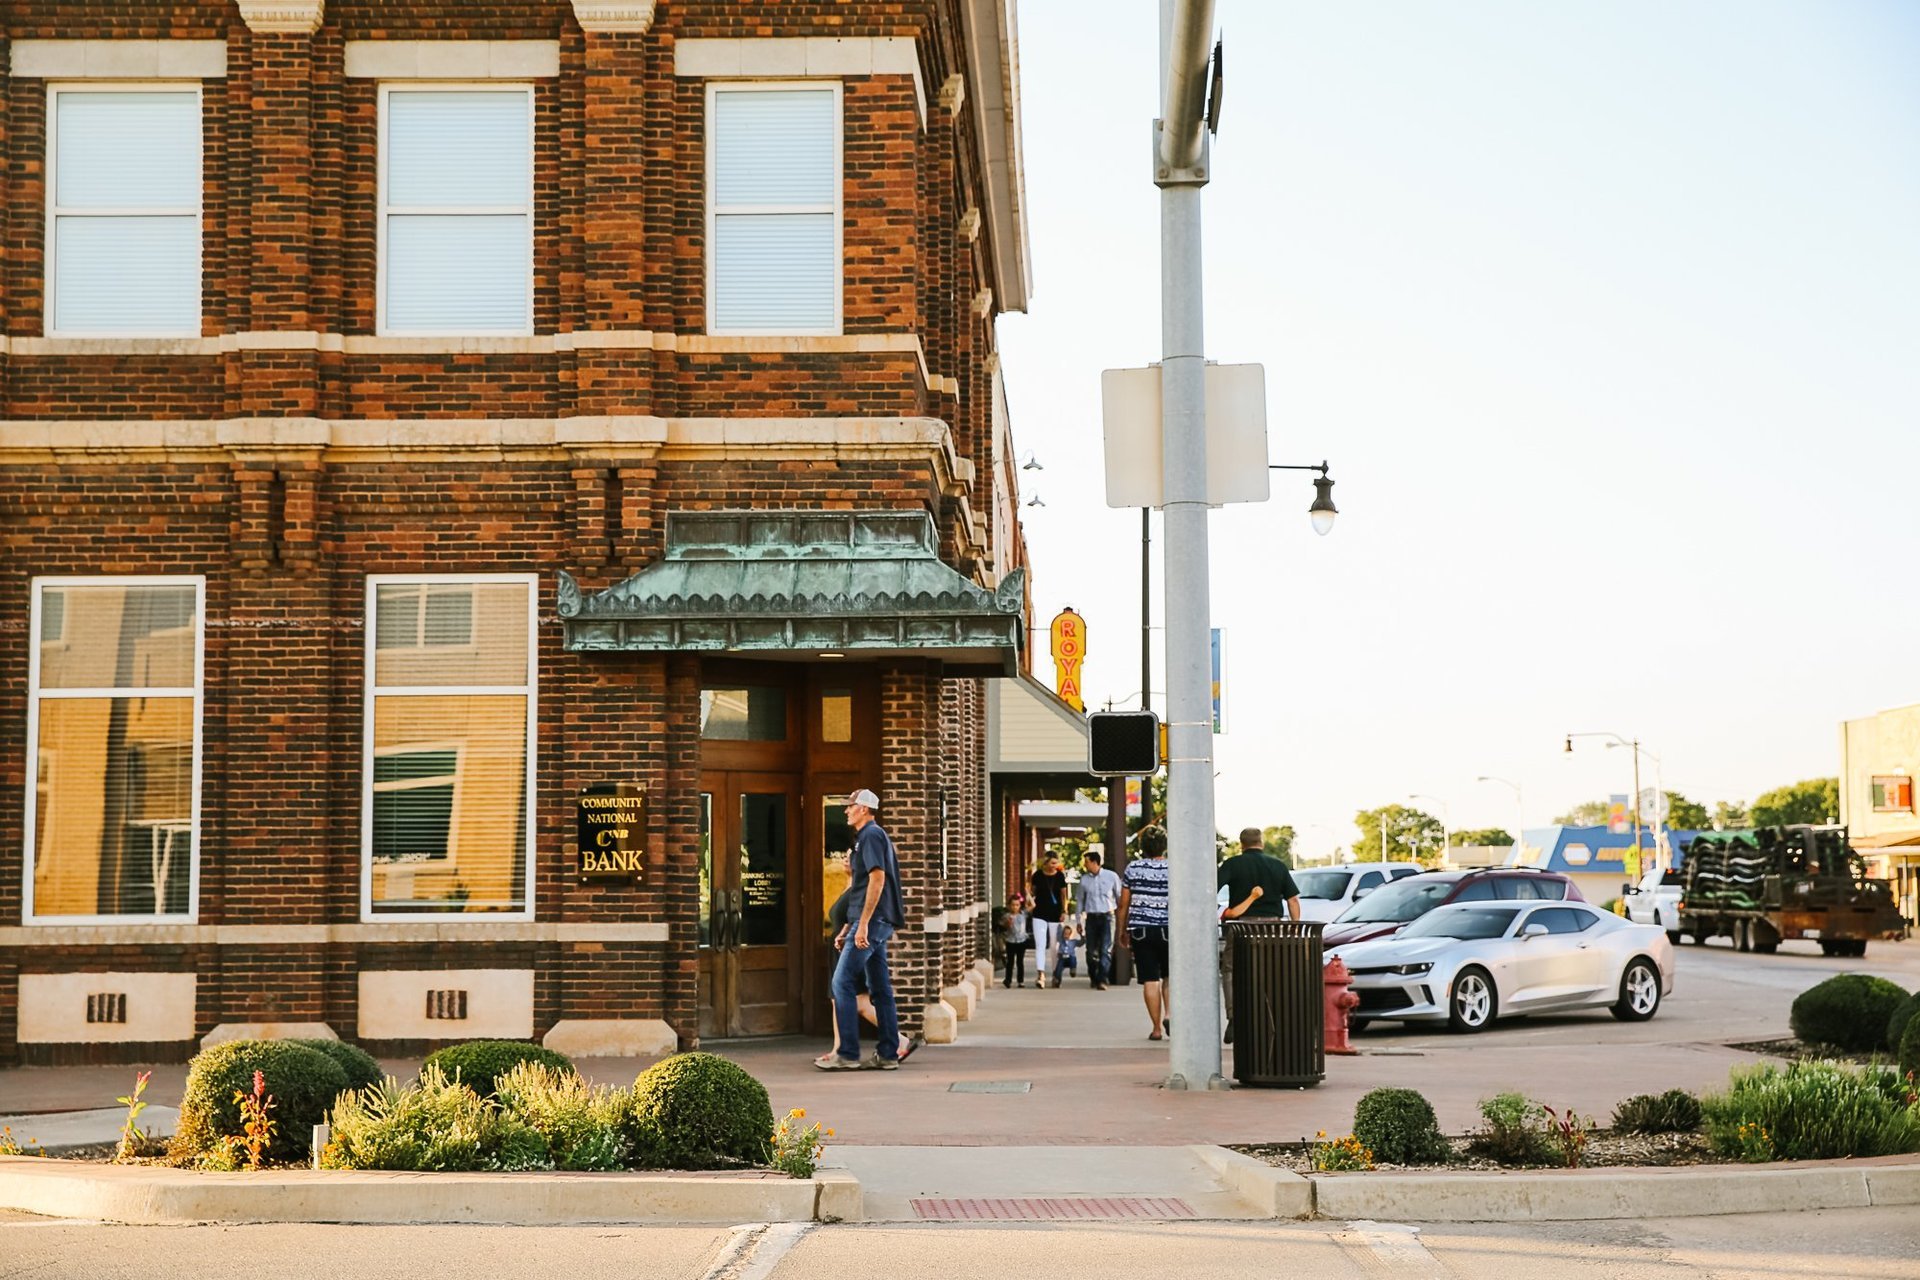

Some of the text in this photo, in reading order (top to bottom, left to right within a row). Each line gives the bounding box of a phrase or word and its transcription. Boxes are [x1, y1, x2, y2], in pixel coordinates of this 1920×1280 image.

[1059, 619, 1078, 703] ROYA
[582, 797, 642, 809] COMMUNITY
[587, 813, 638, 824] NATIONAL
[582, 850, 643, 871] BANK
